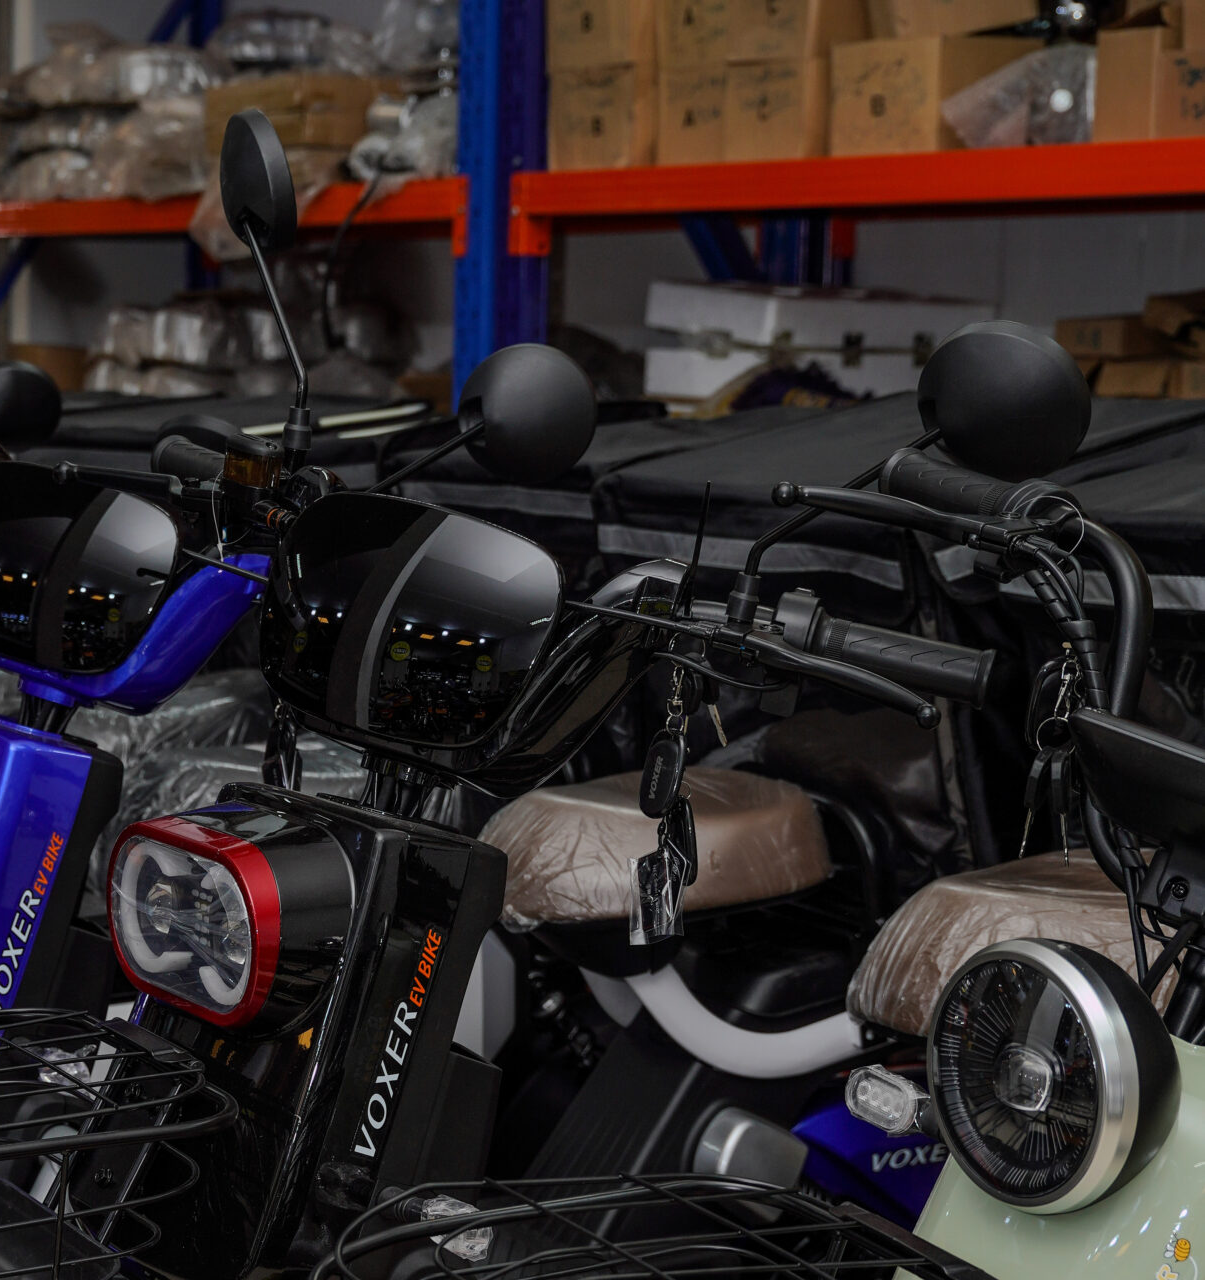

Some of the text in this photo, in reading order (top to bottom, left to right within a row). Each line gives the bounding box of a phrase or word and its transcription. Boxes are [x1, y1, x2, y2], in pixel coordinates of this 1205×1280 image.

[648, 756, 664, 800] VOXER
[33, 870, 48, 895] EV
[42, 831, 64, 873] BIKE
[354, 928, 442, 1157] VOXER EV BIKE
[872, 1142, 948, 1173] VOXE
